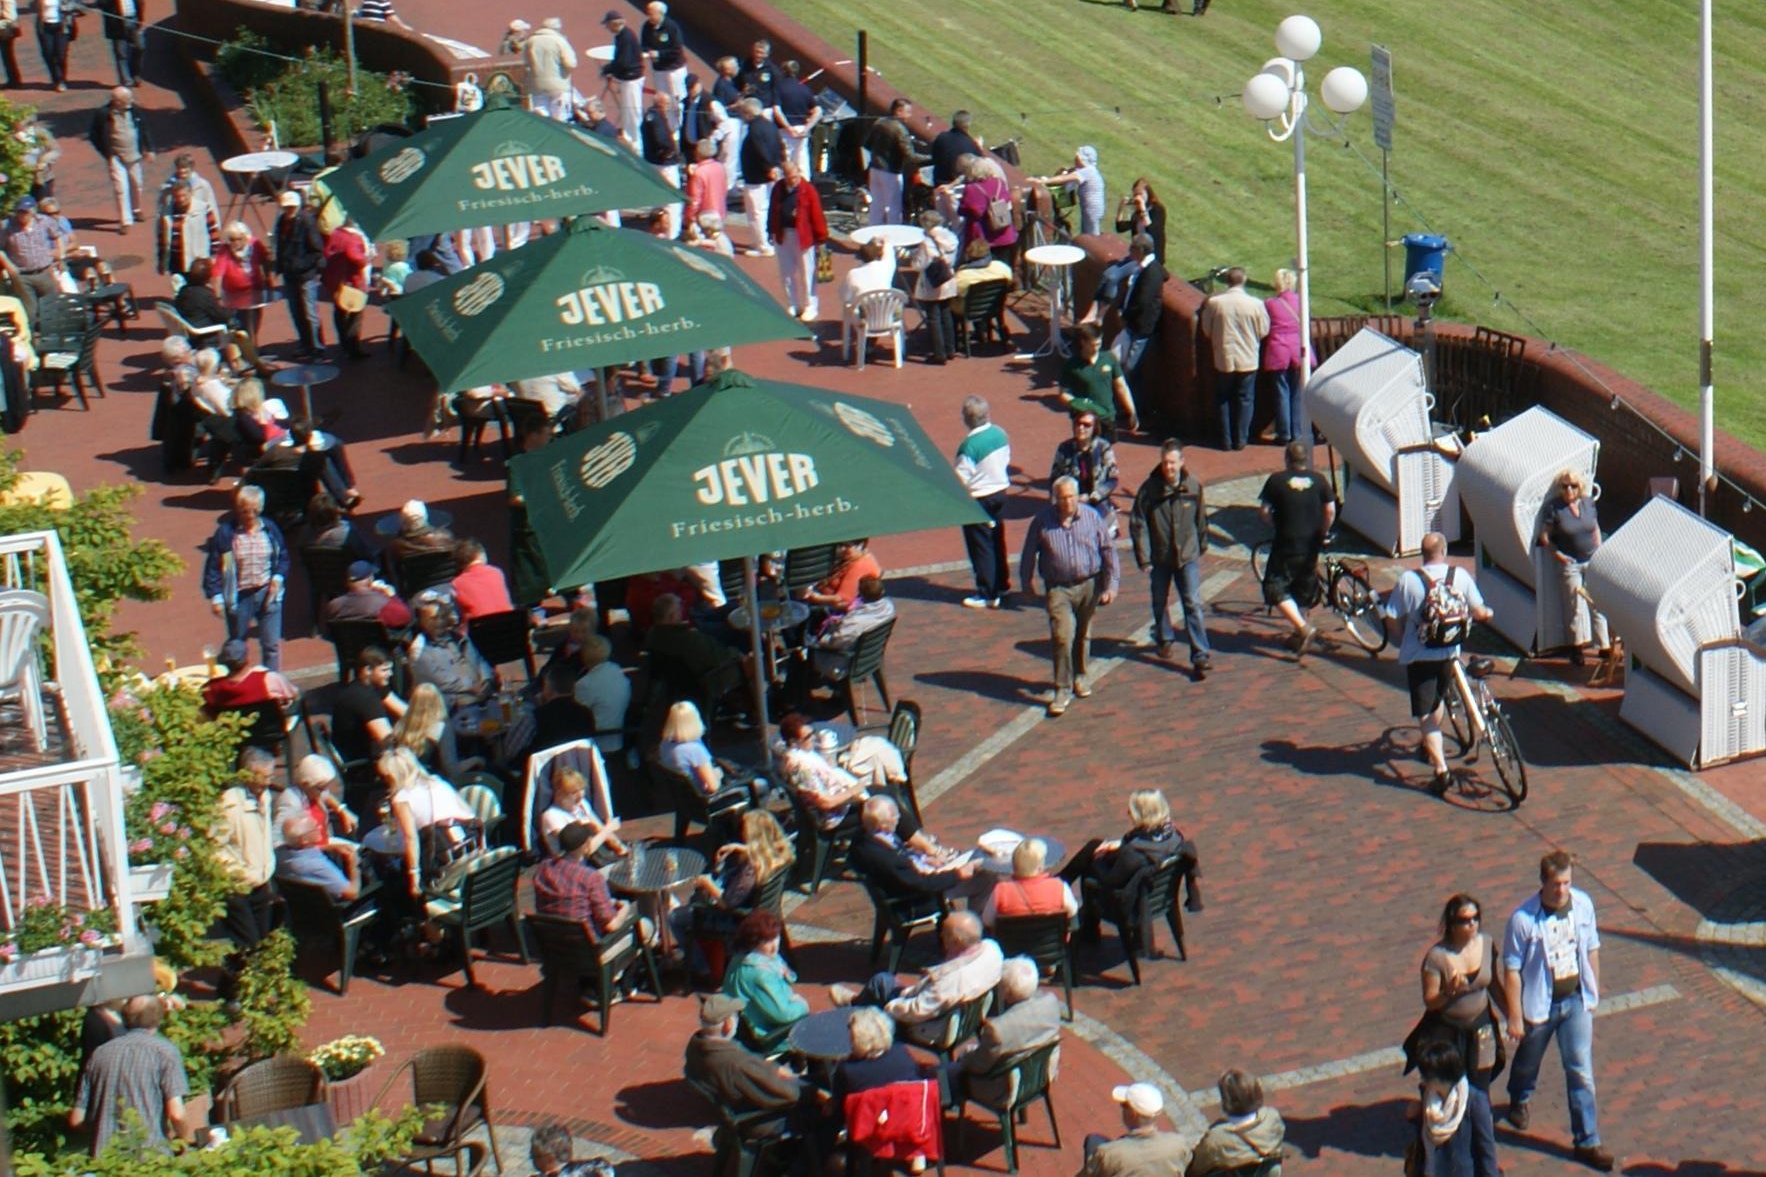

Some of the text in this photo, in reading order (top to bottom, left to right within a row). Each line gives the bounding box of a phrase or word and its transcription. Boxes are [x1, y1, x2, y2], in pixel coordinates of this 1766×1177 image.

[471, 154, 566, 190] JEVER
[456, 184, 599, 212] Friesisch-herb.
[555, 282, 666, 325] JEVER
[540, 316, 702, 353] Friesisch-herb.
[693, 452, 819, 506] JEVER
[670, 496, 860, 539] Friesisch-herb.
